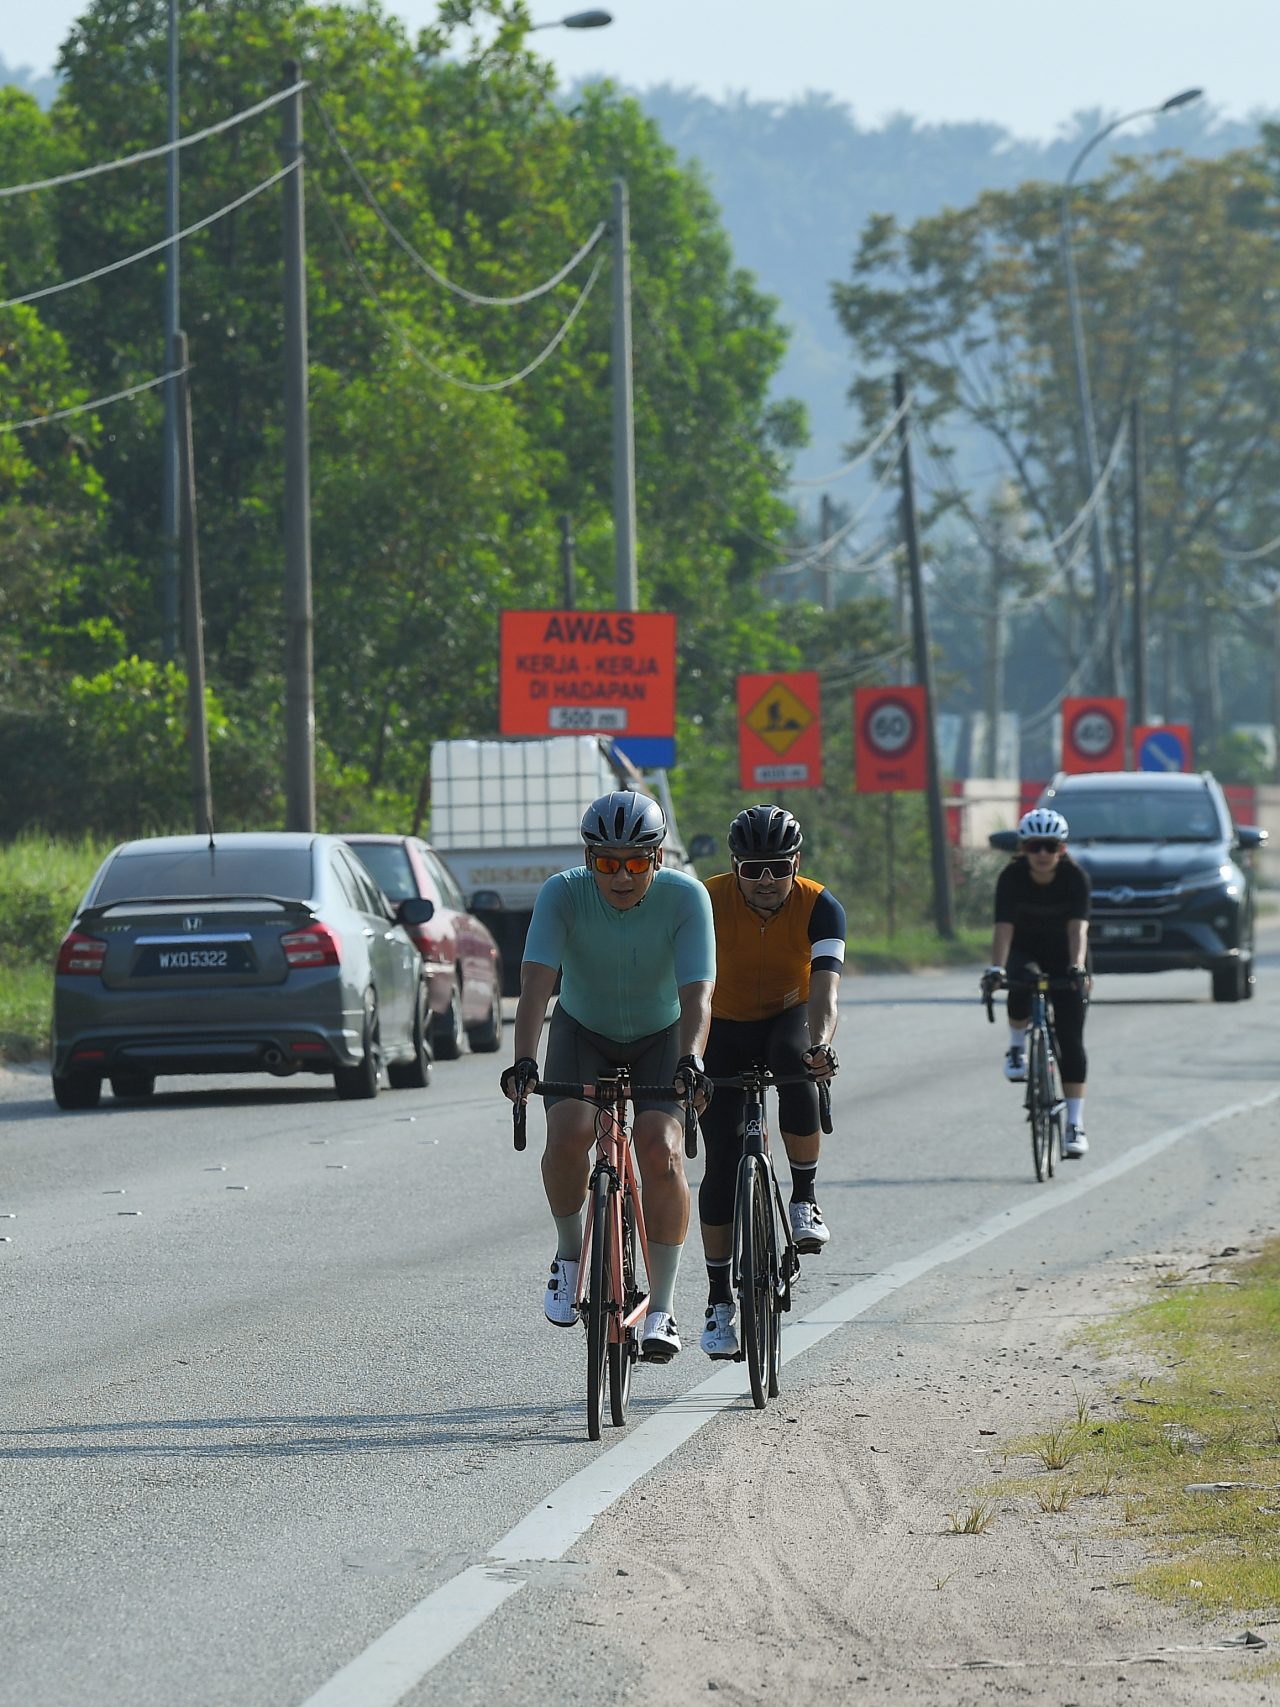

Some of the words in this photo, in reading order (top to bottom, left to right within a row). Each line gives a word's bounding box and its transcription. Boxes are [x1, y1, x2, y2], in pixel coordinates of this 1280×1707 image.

[544, 616, 635, 645] AWAS
[516, 654, 580, 674] KERJA
[596, 655, 659, 675] KERJA
[529, 680, 548, 699] DI
[554, 681, 646, 700] HADAPAN
[560, 708, 593, 727] 500
[598, 714, 618, 727] m
[875, 715, 905, 738] 60
[1080, 725, 1106, 742] 40
